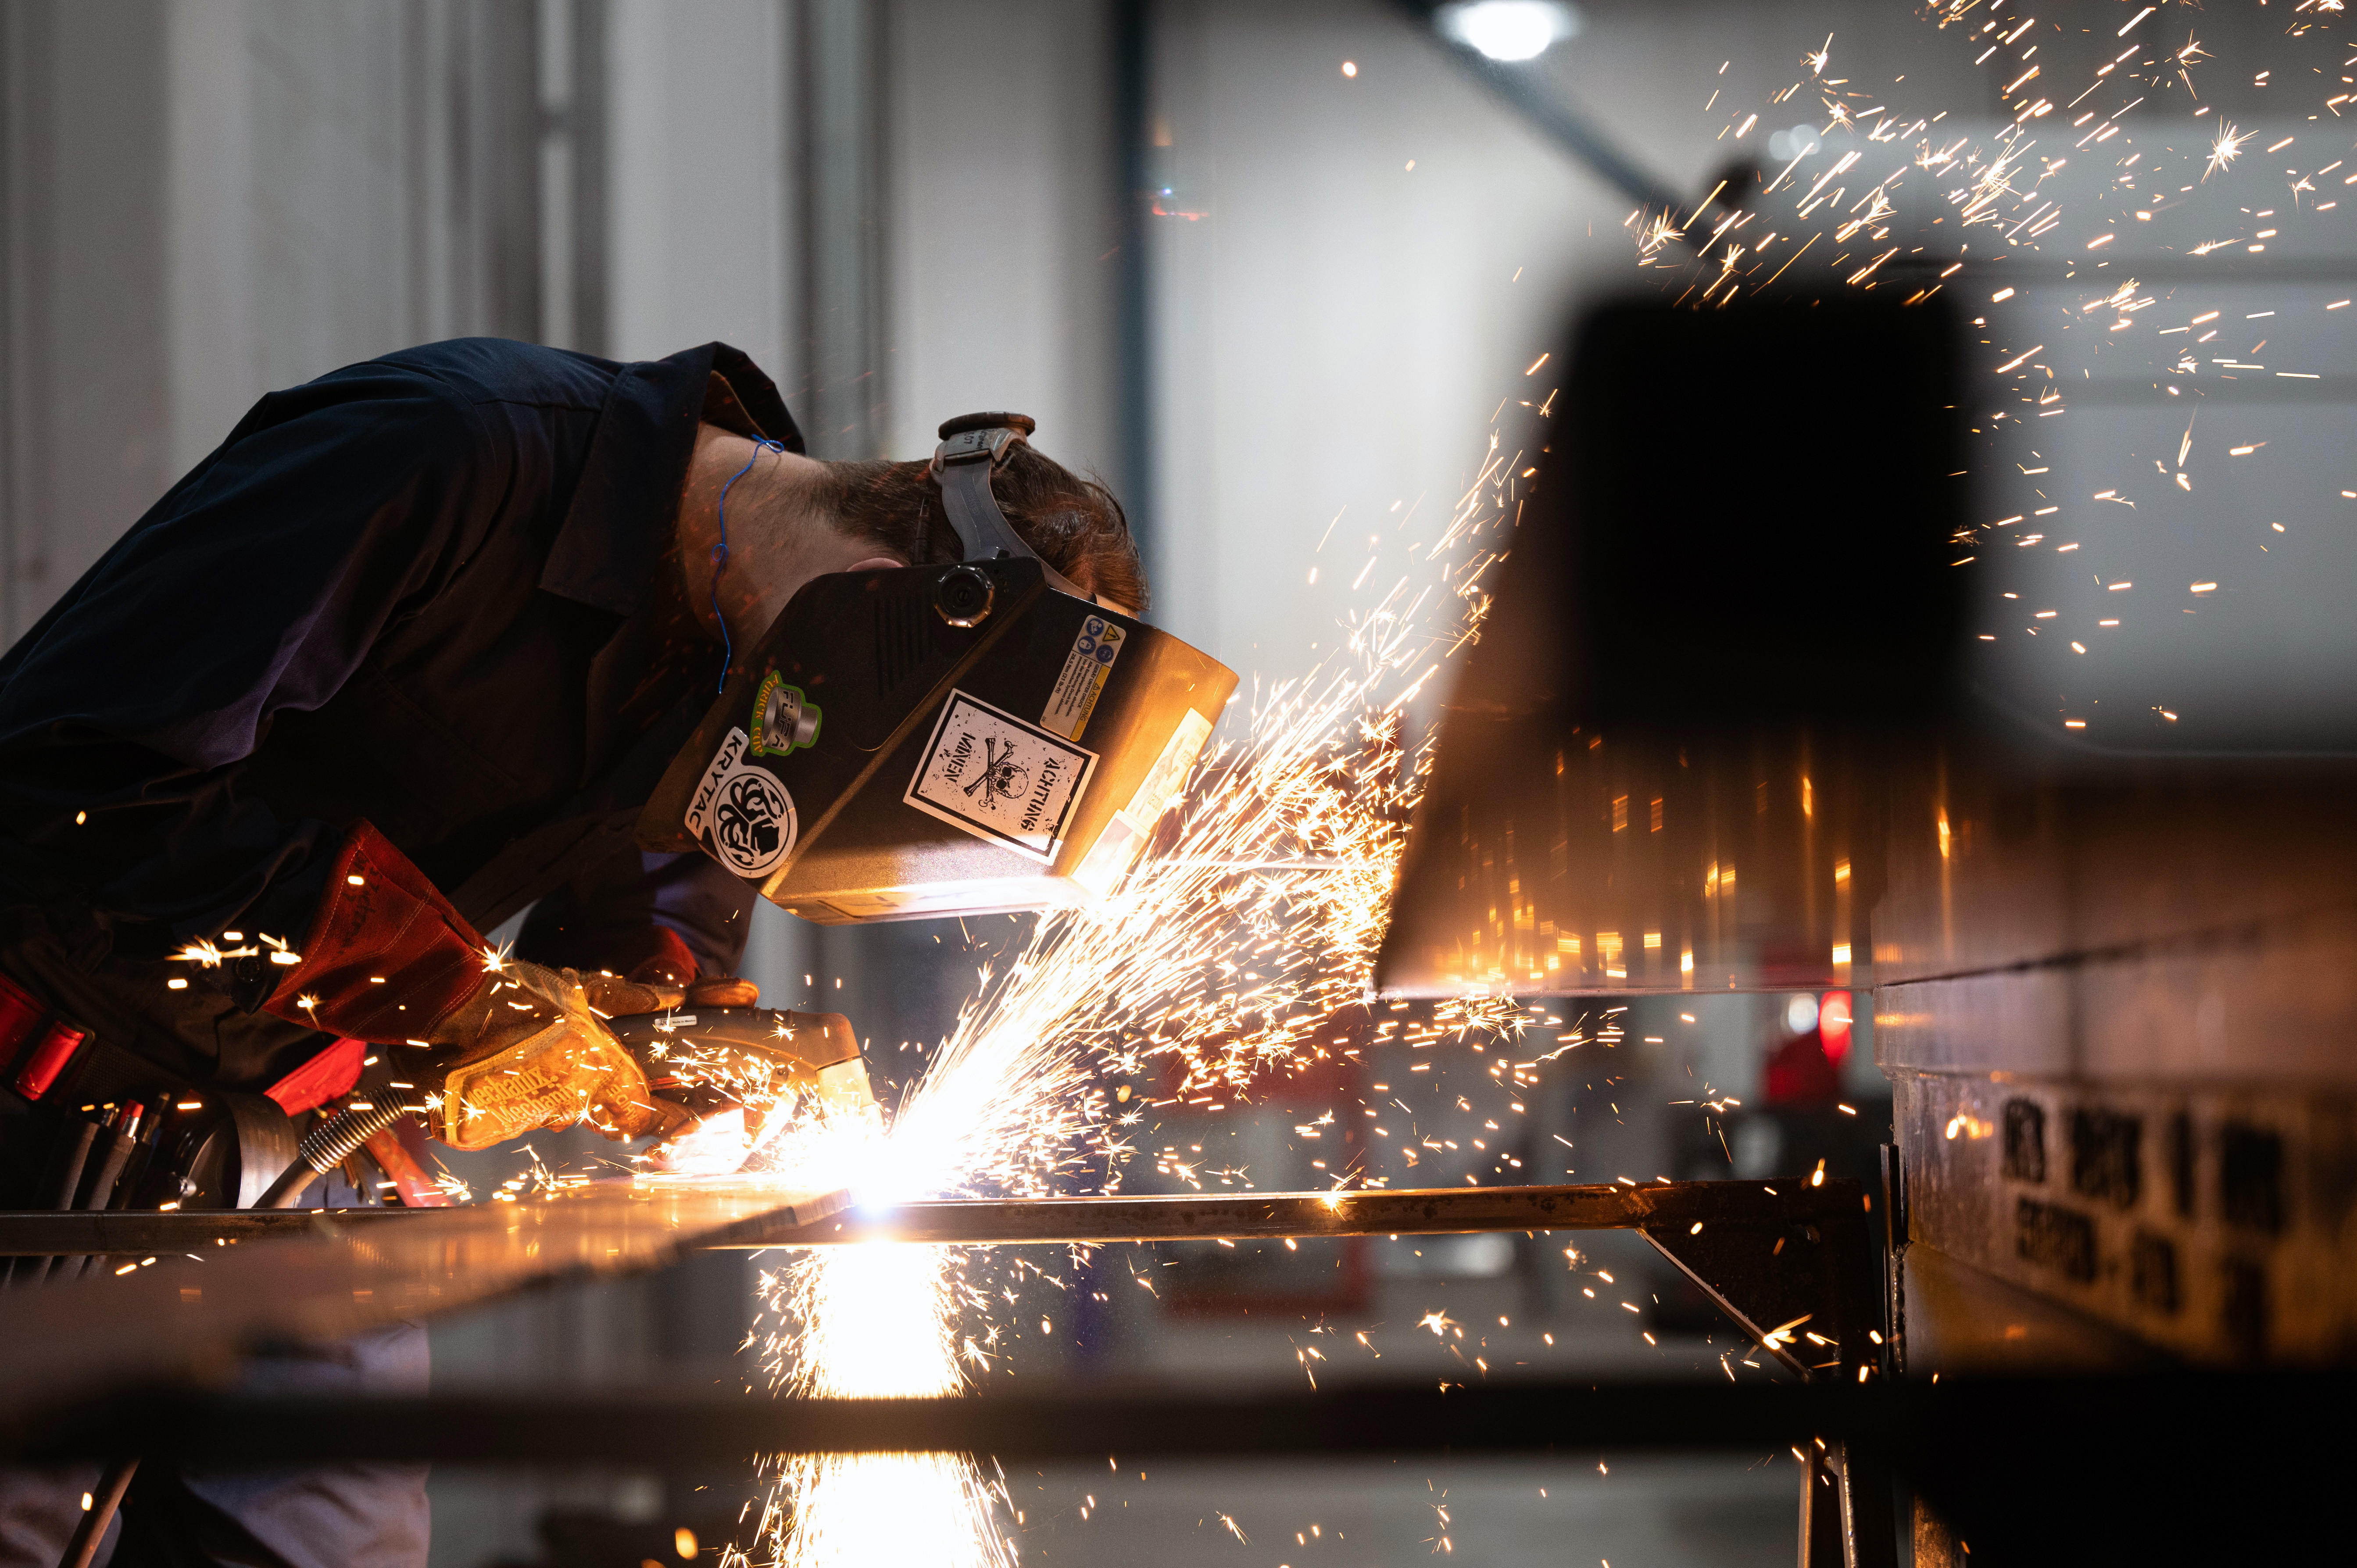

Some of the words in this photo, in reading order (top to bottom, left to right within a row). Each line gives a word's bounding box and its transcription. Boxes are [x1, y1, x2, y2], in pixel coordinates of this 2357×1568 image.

[1064, 664, 1071, 673] Nm
[1067, 656, 1083, 685] pneumatischen
[1068, 653, 1077, 664] 28,5
[1090, 664, 1100, 679] GERÄT
[1061, 684, 1070, 698] System
[1071, 671, 1082, 689] Wartung
[1074, 668, 1089, 696] Energiequellen
[1084, 678, 1093, 693] UNTER
[754, 673, 779, 720] FURICK
[1077, 692, 1087, 709] DRUCK
[1079, 690, 1096, 721] ACHTUNG
[751, 727, 762, 753] CUP
[943, 732, 976, 783] MINEN
[688, 734, 742, 831] KRYTAC
[1019, 757, 1061, 832] ACHTUNG
[605, 1083, 640, 1128] RAHIDE
